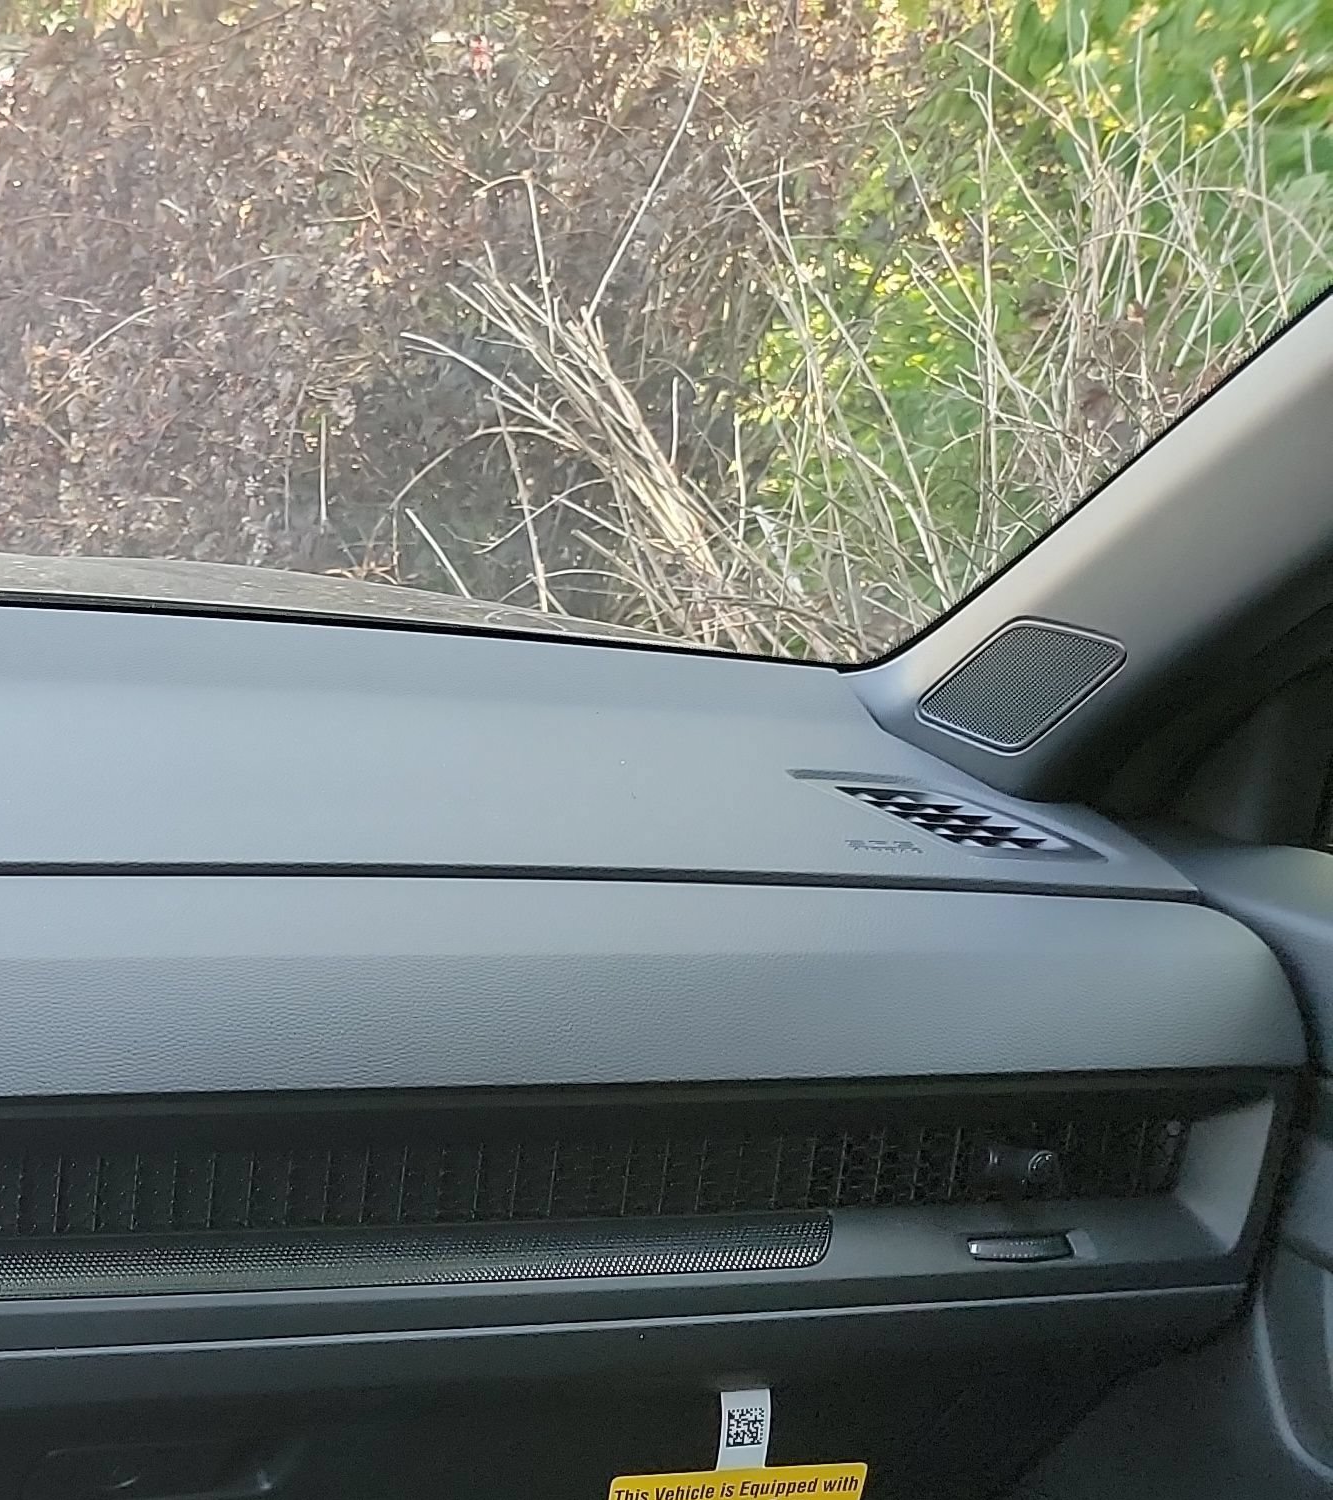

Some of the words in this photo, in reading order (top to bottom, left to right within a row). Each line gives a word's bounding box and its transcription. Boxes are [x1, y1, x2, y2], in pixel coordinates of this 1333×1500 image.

[720, 1482, 734, 1498] is
[739, 1477, 818, 1499] Equipped
[823, 1475, 859, 1492] with
